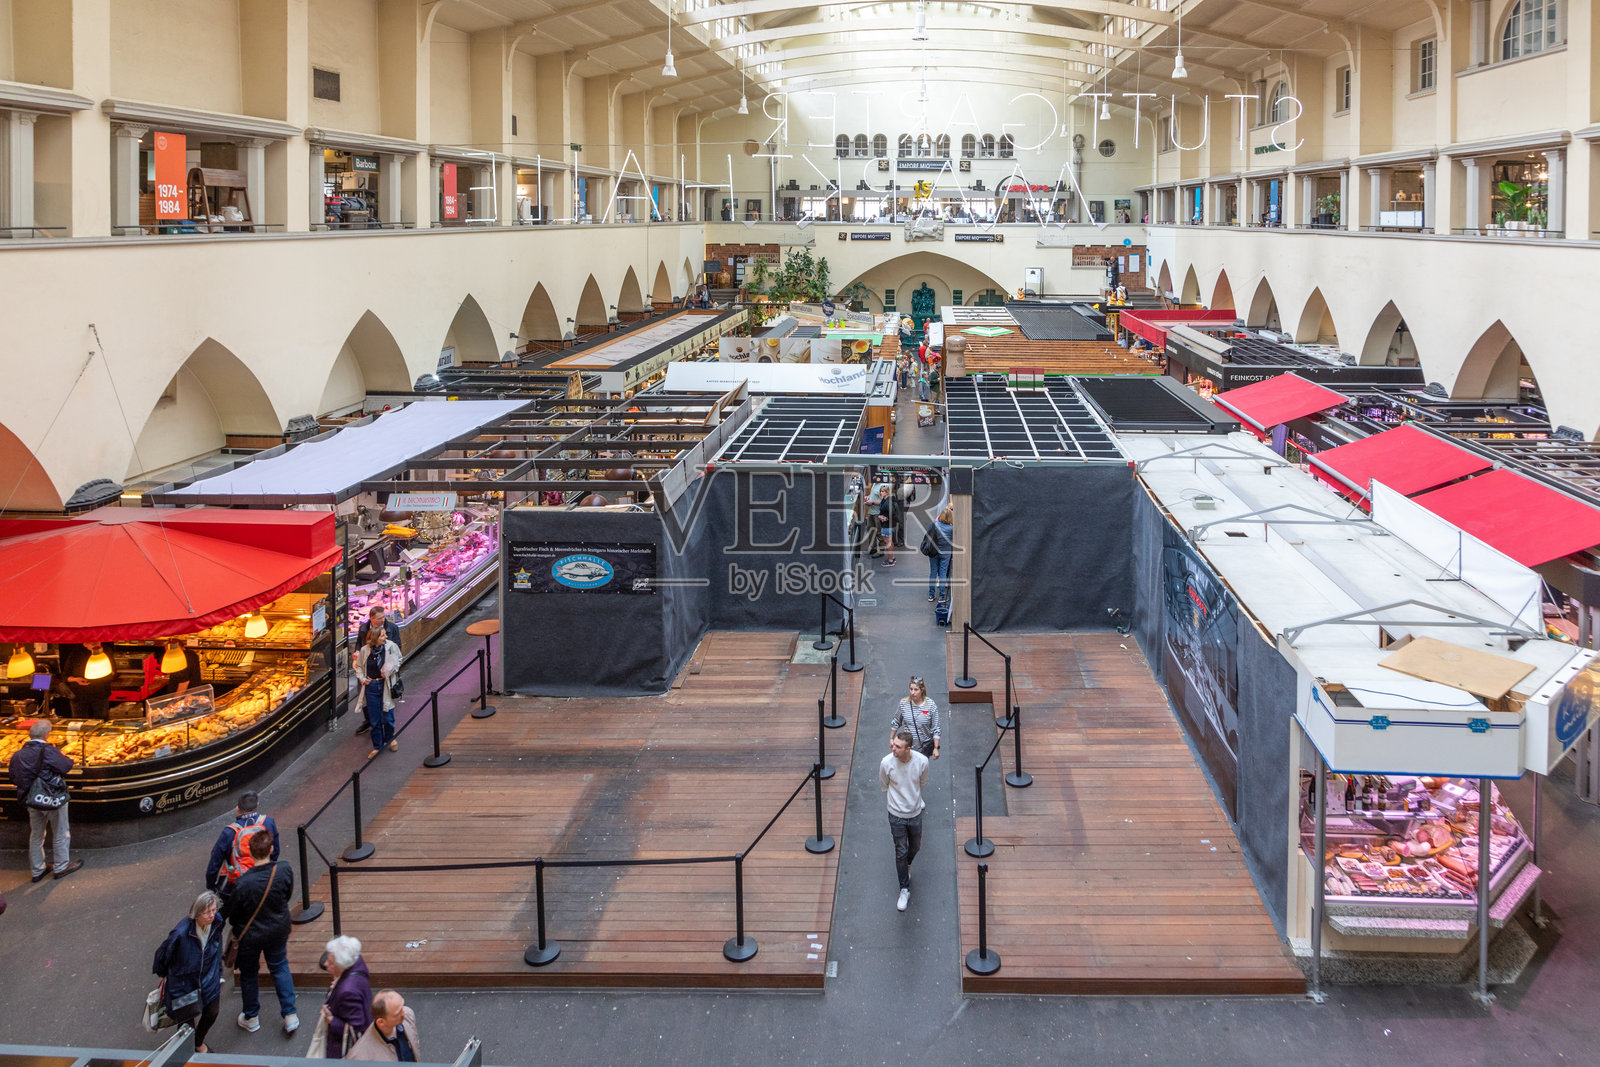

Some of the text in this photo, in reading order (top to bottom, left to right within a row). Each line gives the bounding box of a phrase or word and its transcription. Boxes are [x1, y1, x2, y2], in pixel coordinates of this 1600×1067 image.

[355, 158, 377, 169] Barbour
[914, 182, 933, 199] 15
[158, 200, 181, 213] 1984
[559, 555, 606, 566] FISCHHALLE
[156, 792, 182, 809] Emil
[184, 779, 229, 801] Reimann
